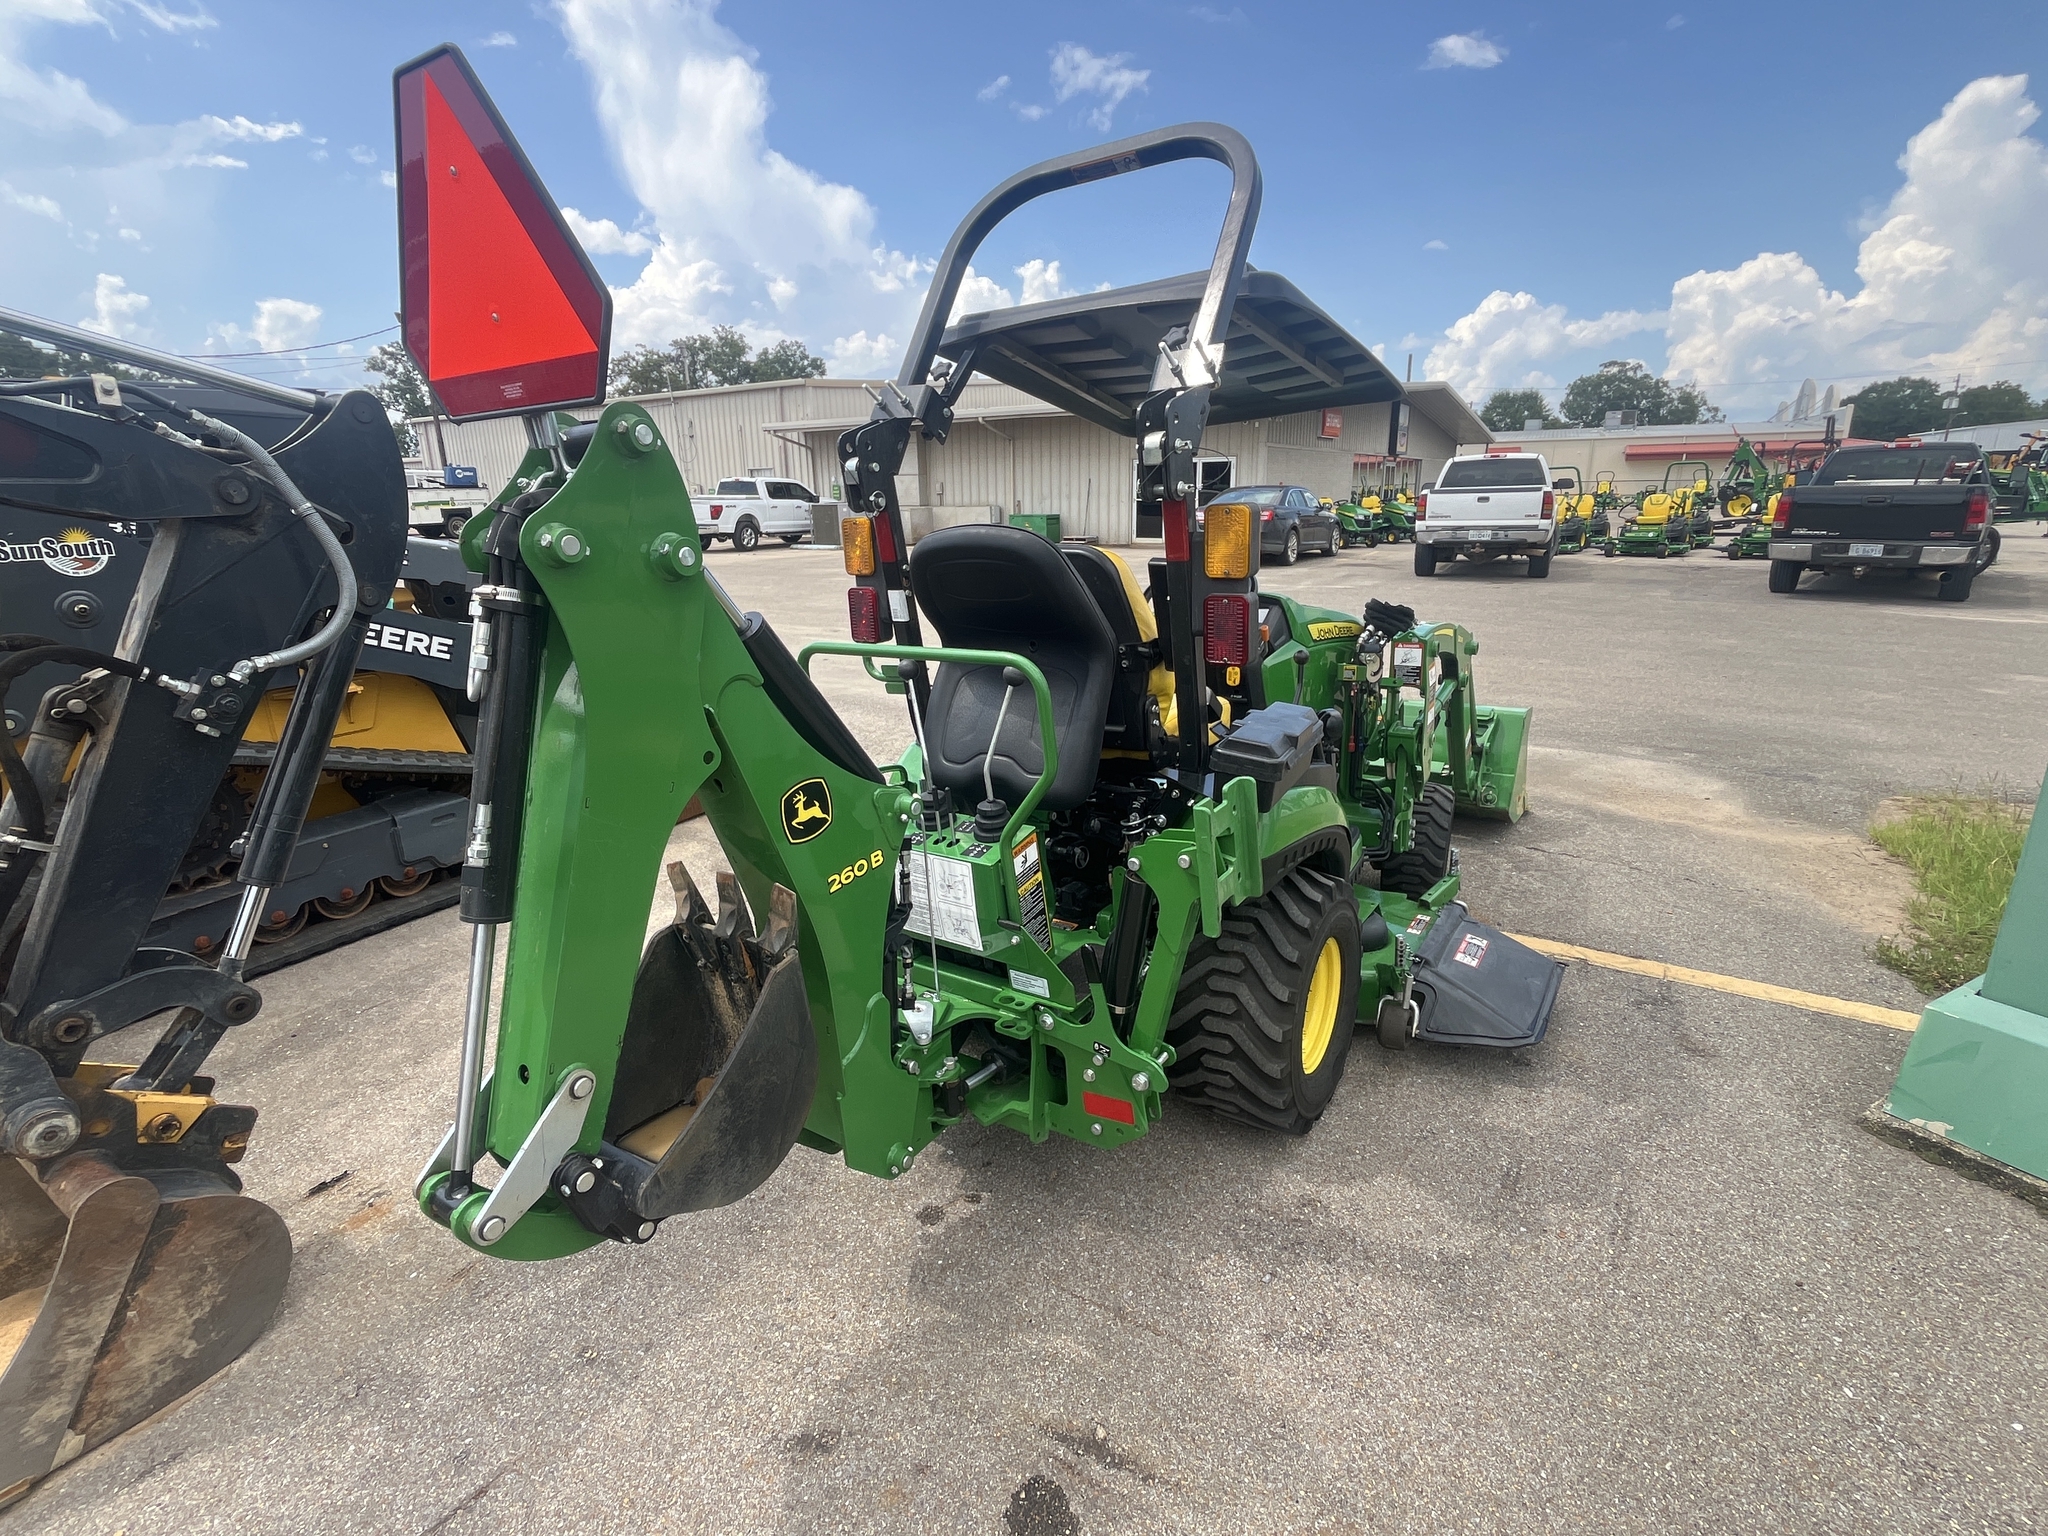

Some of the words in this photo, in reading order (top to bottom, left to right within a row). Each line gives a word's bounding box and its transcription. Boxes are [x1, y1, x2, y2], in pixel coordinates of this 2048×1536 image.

[0, 537, 115, 562] SunSouth
[364, 622, 454, 660] EERE
[1316, 627, 1335, 639] JOHN
[1334, 625, 1355, 637] DEERE
[827, 858, 869, 895] 260
[870, 848, 885, 870] B
[1020, 876, 1040, 896] CAUTION
